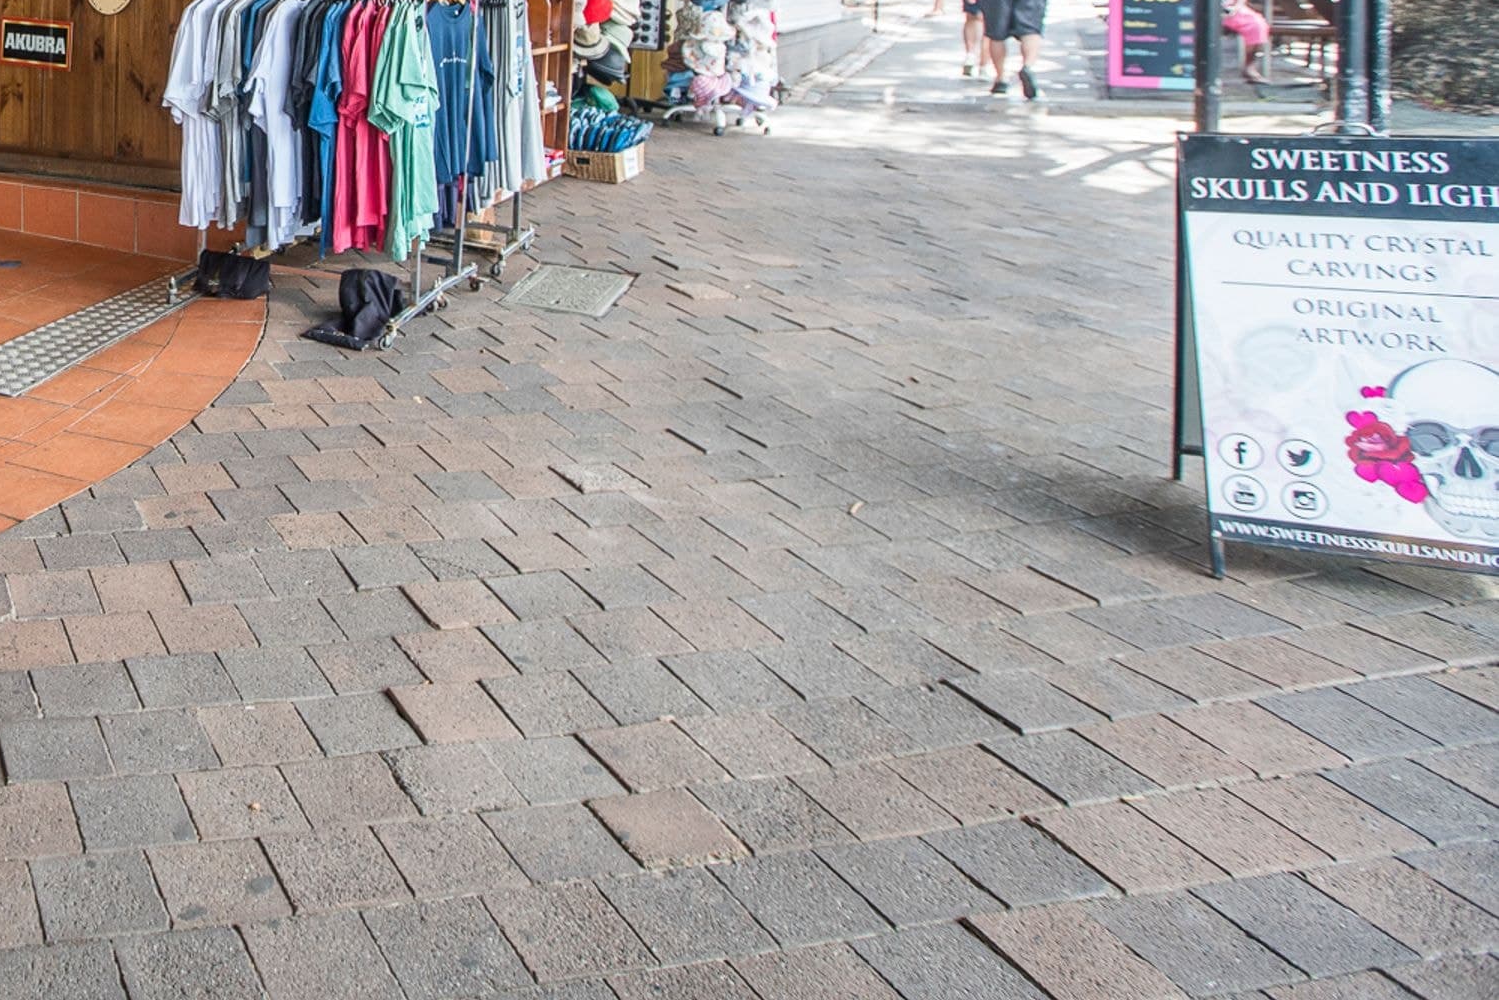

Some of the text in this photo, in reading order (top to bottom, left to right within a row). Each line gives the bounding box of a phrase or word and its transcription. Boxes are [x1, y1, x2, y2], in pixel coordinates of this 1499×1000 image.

[5, 31, 66, 55] AKUBRA
[1251, 148, 1450, 174] SWEETNESS
[1191, 177, 1309, 202] SKULLS
[1316, 181, 1400, 205] AND
[1233, 229, 1494, 257] QUALITY CRYSTAL
[1287, 260, 1438, 282] CARVINGS
[1293, 298, 1443, 324] ORIGINAL
[1295, 328, 1447, 353] ARTWORK
